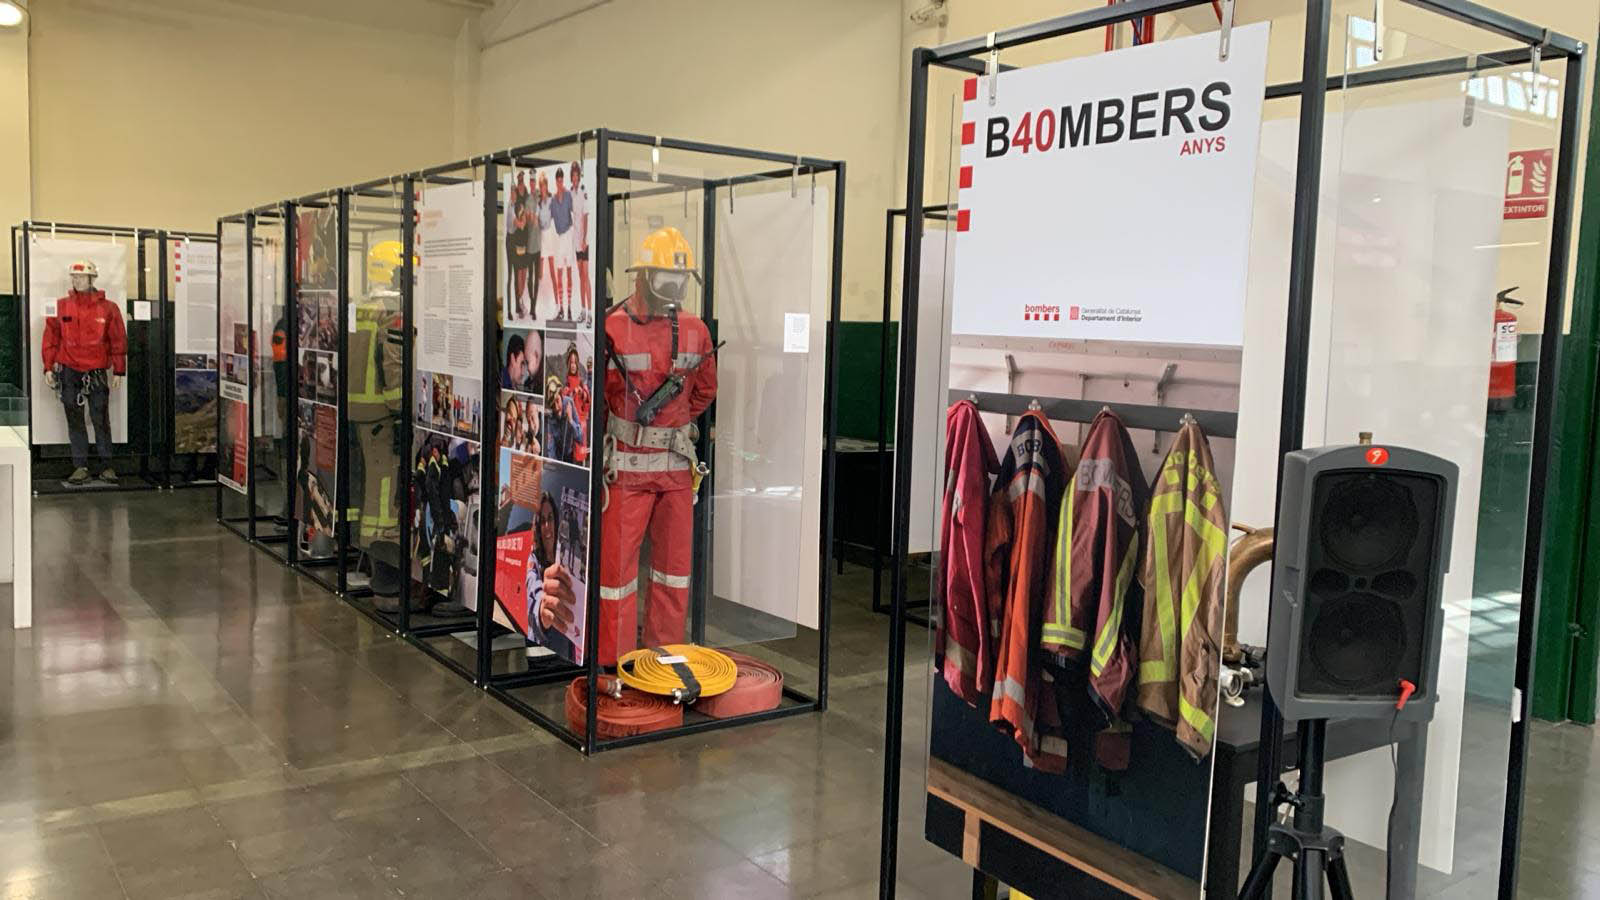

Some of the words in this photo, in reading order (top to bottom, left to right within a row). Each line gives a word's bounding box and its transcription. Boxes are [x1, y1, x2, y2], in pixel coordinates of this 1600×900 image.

[985, 81, 1232, 158] B40MBERS
[1179, 136, 1226, 156] ANYS
[1024, 304, 1060, 314] bombers
[1081, 314, 1116, 322] Departament
[1371, 449, 1382, 464] 9
